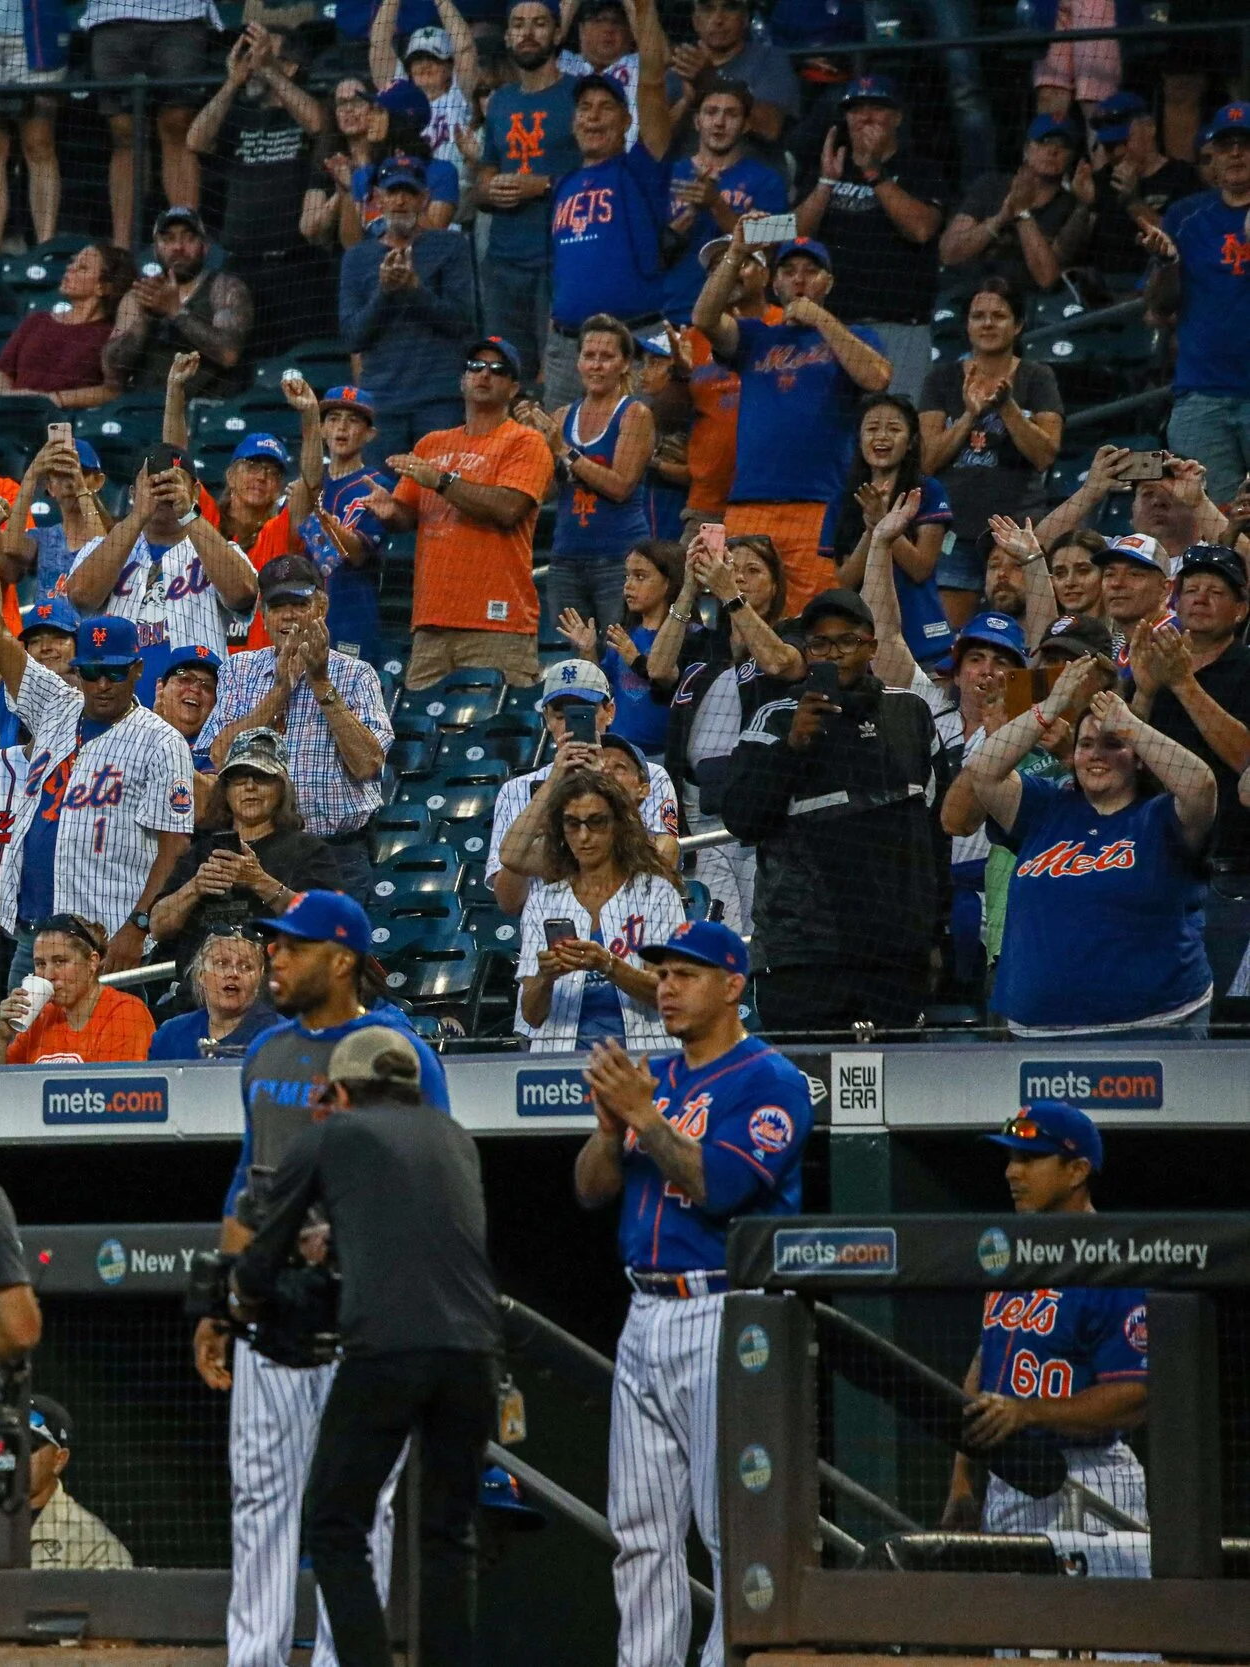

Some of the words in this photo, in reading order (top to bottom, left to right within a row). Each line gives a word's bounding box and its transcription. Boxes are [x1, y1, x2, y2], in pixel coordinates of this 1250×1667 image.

[506, 111, 547, 175] NY
[552, 188, 613, 234] METS
[91, 627, 106, 647] NY
[561, 665, 578, 684] NY
[92, 815, 103, 854] 1
[1016, 840, 1136, 878] Mets
[839, 1066, 877, 1087] NEW
[1026, 1069, 1156, 1098] mets.com
[48, 1086, 163, 1115] mets.com
[840, 1089, 877, 1109] ERA
[131, 1249, 175, 1273] New
[782, 1240, 889, 1265] mets.com
[1016, 1239, 1068, 1263] New
[1073, 1239, 1123, 1264] York
[1128, 1240, 1209, 1269] Lottery
[1010, 1347, 1073, 1399] 60
